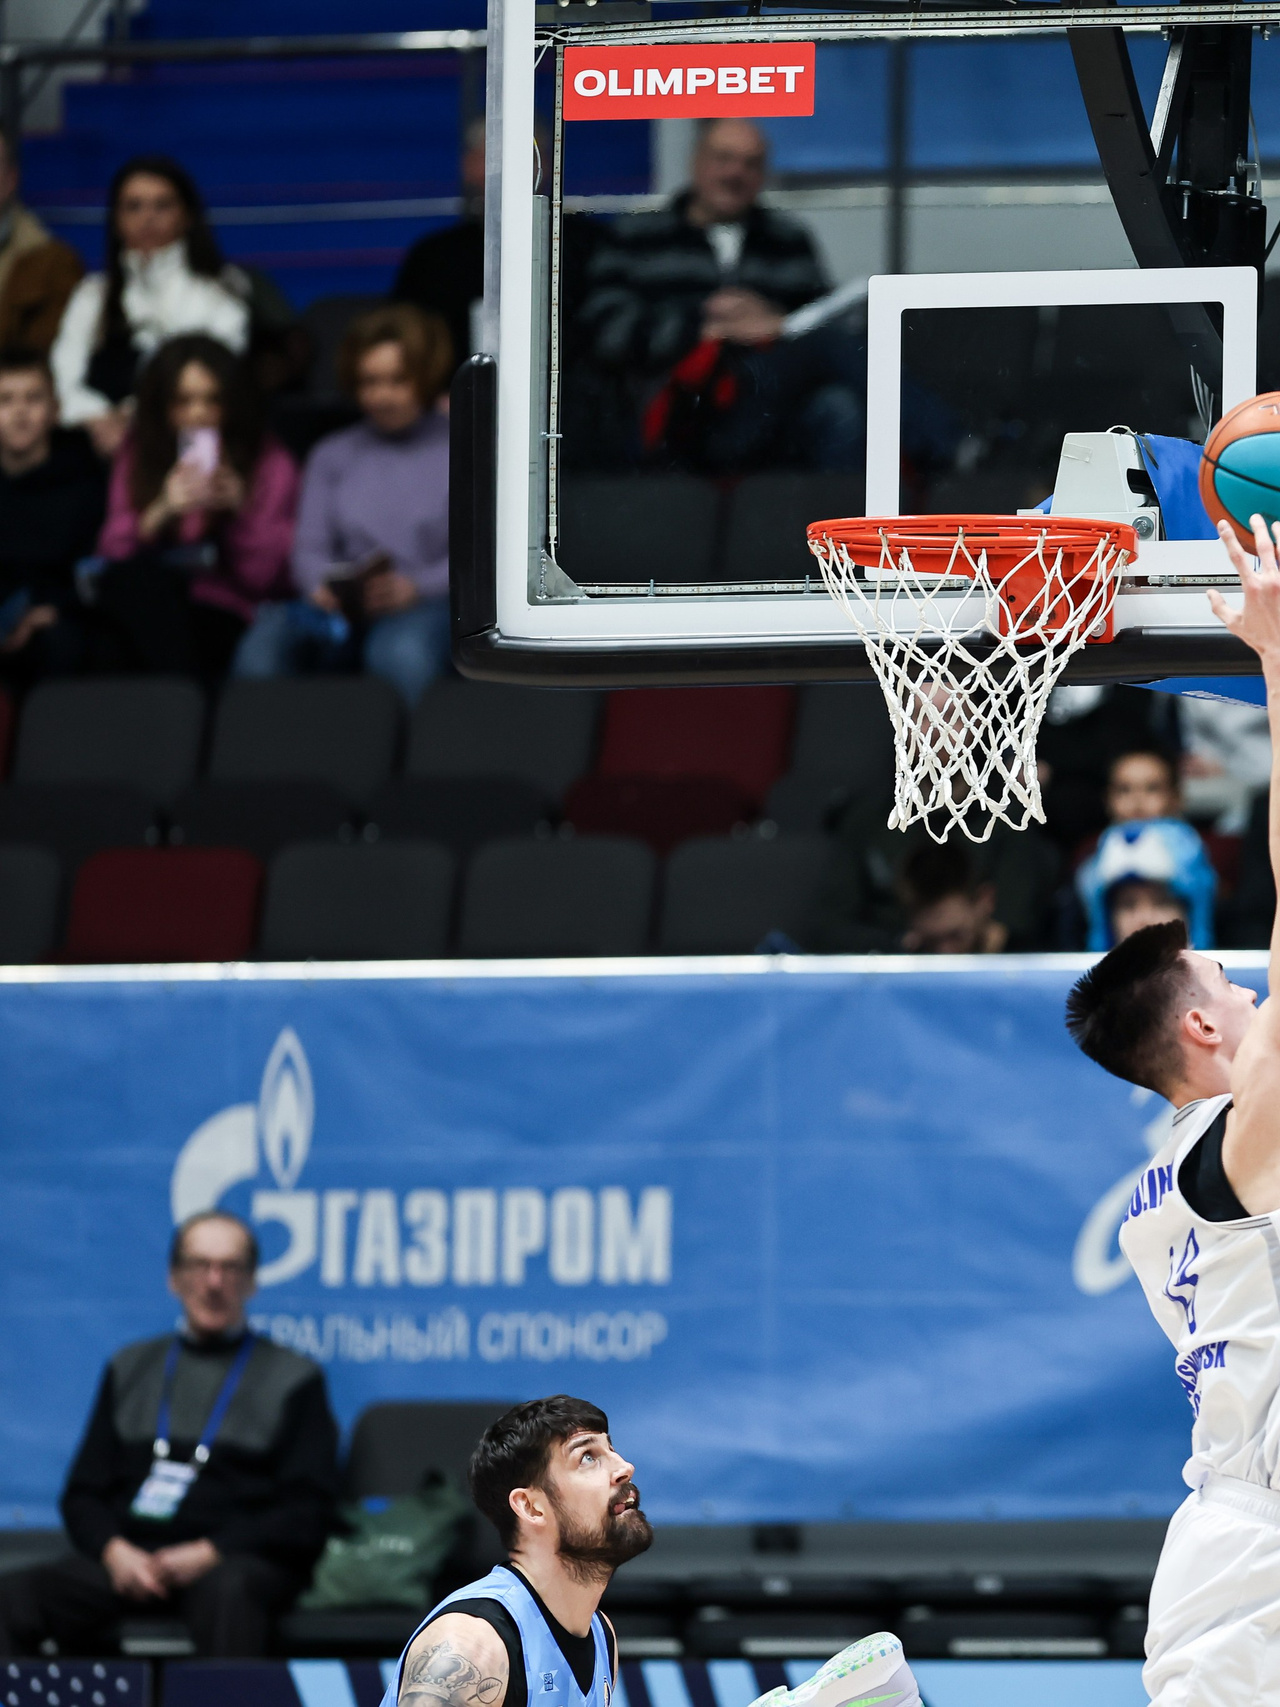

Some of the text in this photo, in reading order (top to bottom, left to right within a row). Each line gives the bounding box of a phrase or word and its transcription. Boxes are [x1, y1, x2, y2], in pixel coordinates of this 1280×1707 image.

[573, 65, 805, 98] OLIMPBET
[320, 1186, 673, 1288] ГАЗПРОМ
[477, 1309, 669, 1363] СПОНСОР
